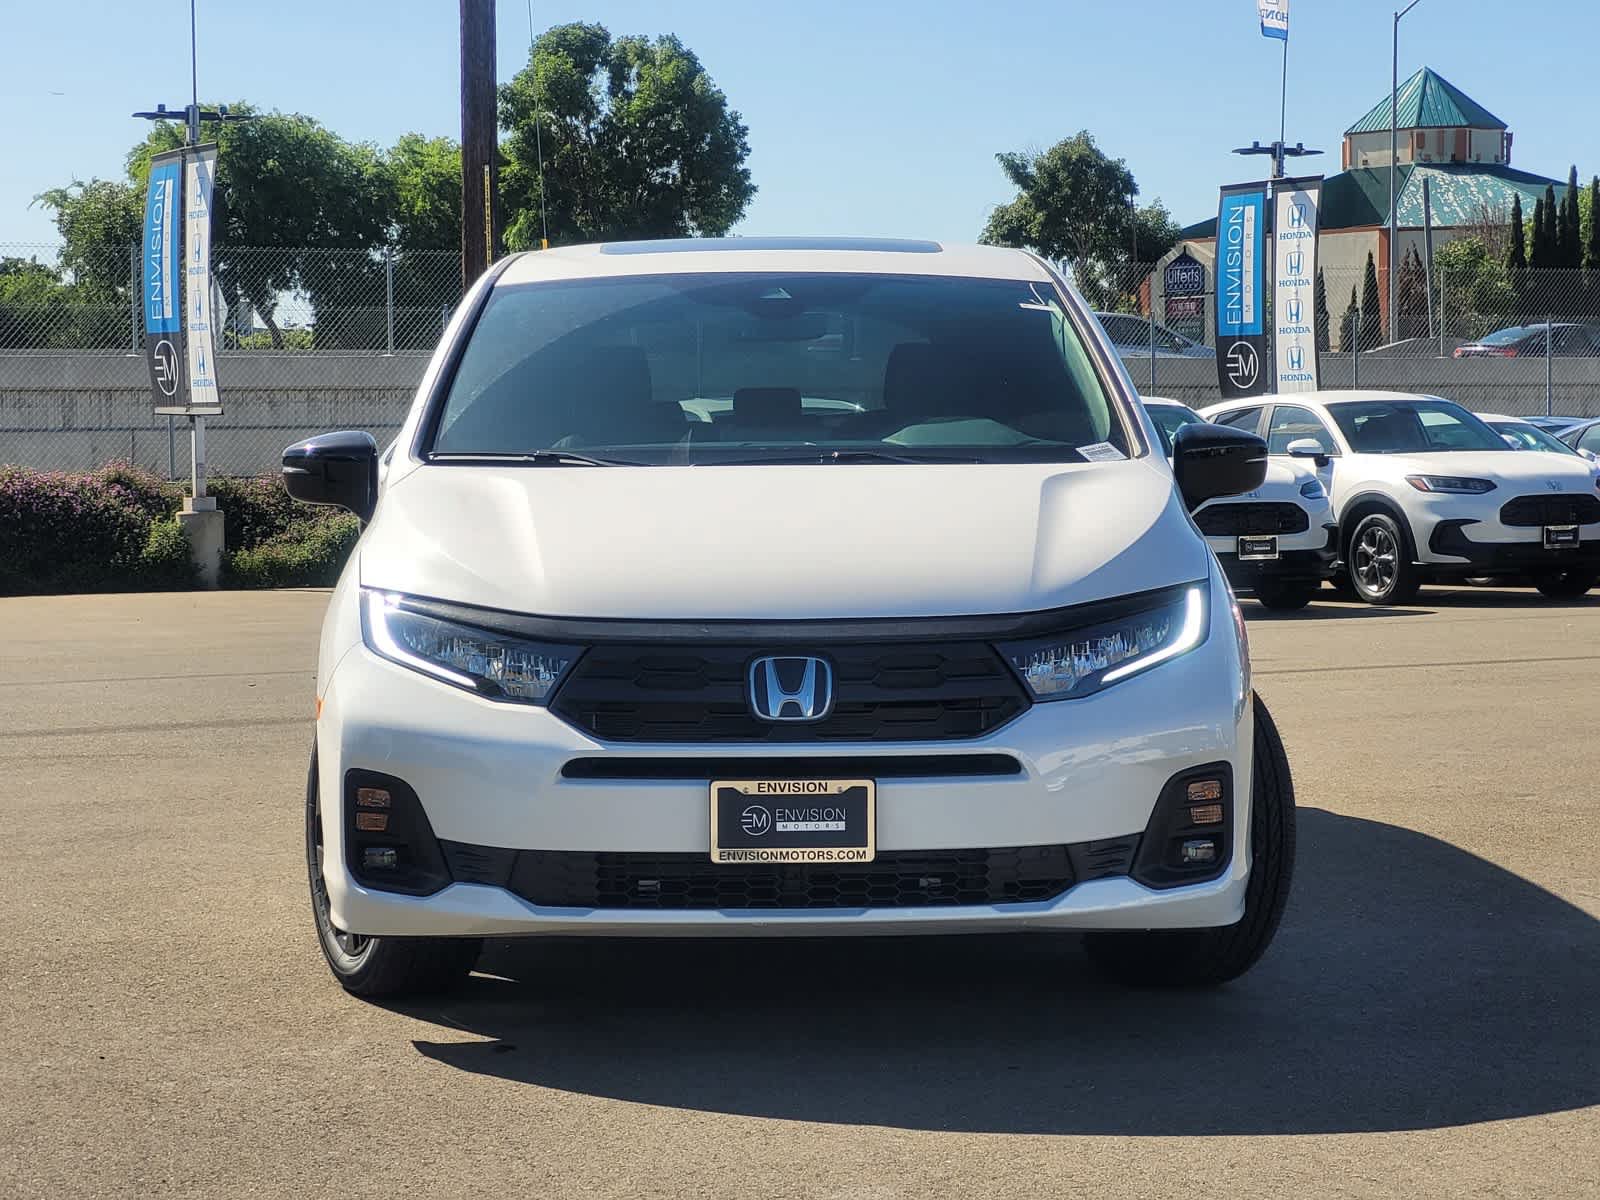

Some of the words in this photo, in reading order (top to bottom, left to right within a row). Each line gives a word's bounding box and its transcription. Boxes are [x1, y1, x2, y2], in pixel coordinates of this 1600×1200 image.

[1280, 231, 1312, 240] HONDA
[151, 181, 165, 320] ENVISION
[1226, 206, 1243, 324] ENVISION
[1245, 216, 1253, 313] MOTORS
[1168, 269, 1200, 283] Ulferts
[1279, 279, 1311, 288] HONDA
[1279, 326, 1311, 335] HONDA
[1280, 374, 1313, 382] HONDA
[757, 782, 828, 793] ENVISION
[776, 808, 846, 821] ENVISION
[719, 850, 867, 861] ENVISIONMOTORS.COM
